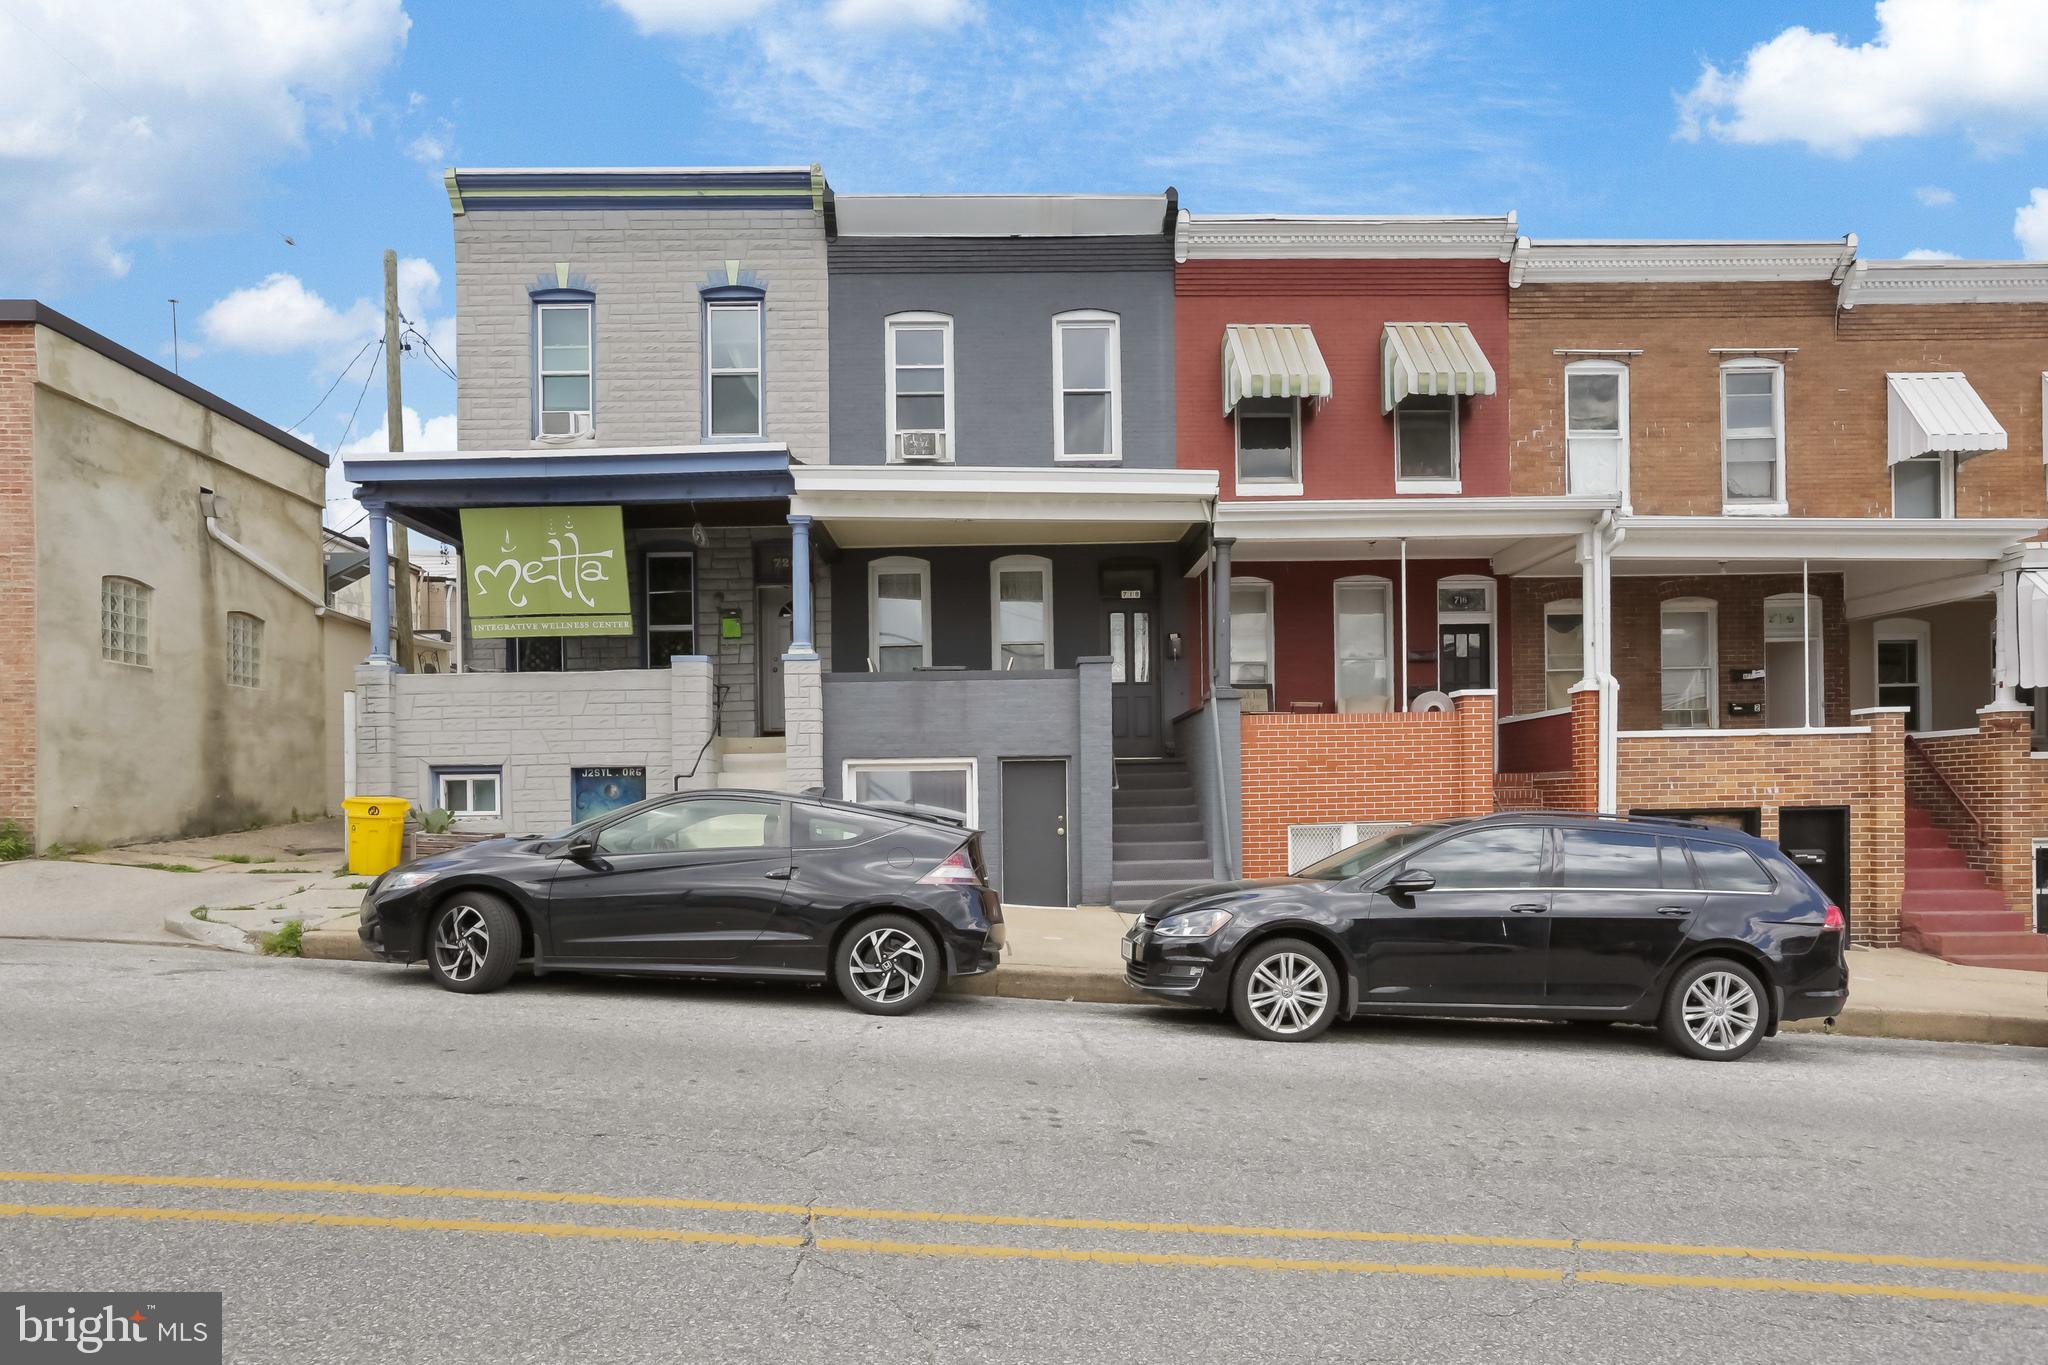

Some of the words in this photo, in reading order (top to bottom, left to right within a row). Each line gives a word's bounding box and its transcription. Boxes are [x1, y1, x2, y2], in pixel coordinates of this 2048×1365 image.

[474, 623, 538, 632] INTEGRATIVE
[541, 621, 590, 630] WELLNESS
[592, 620, 630, 629] CENTER
